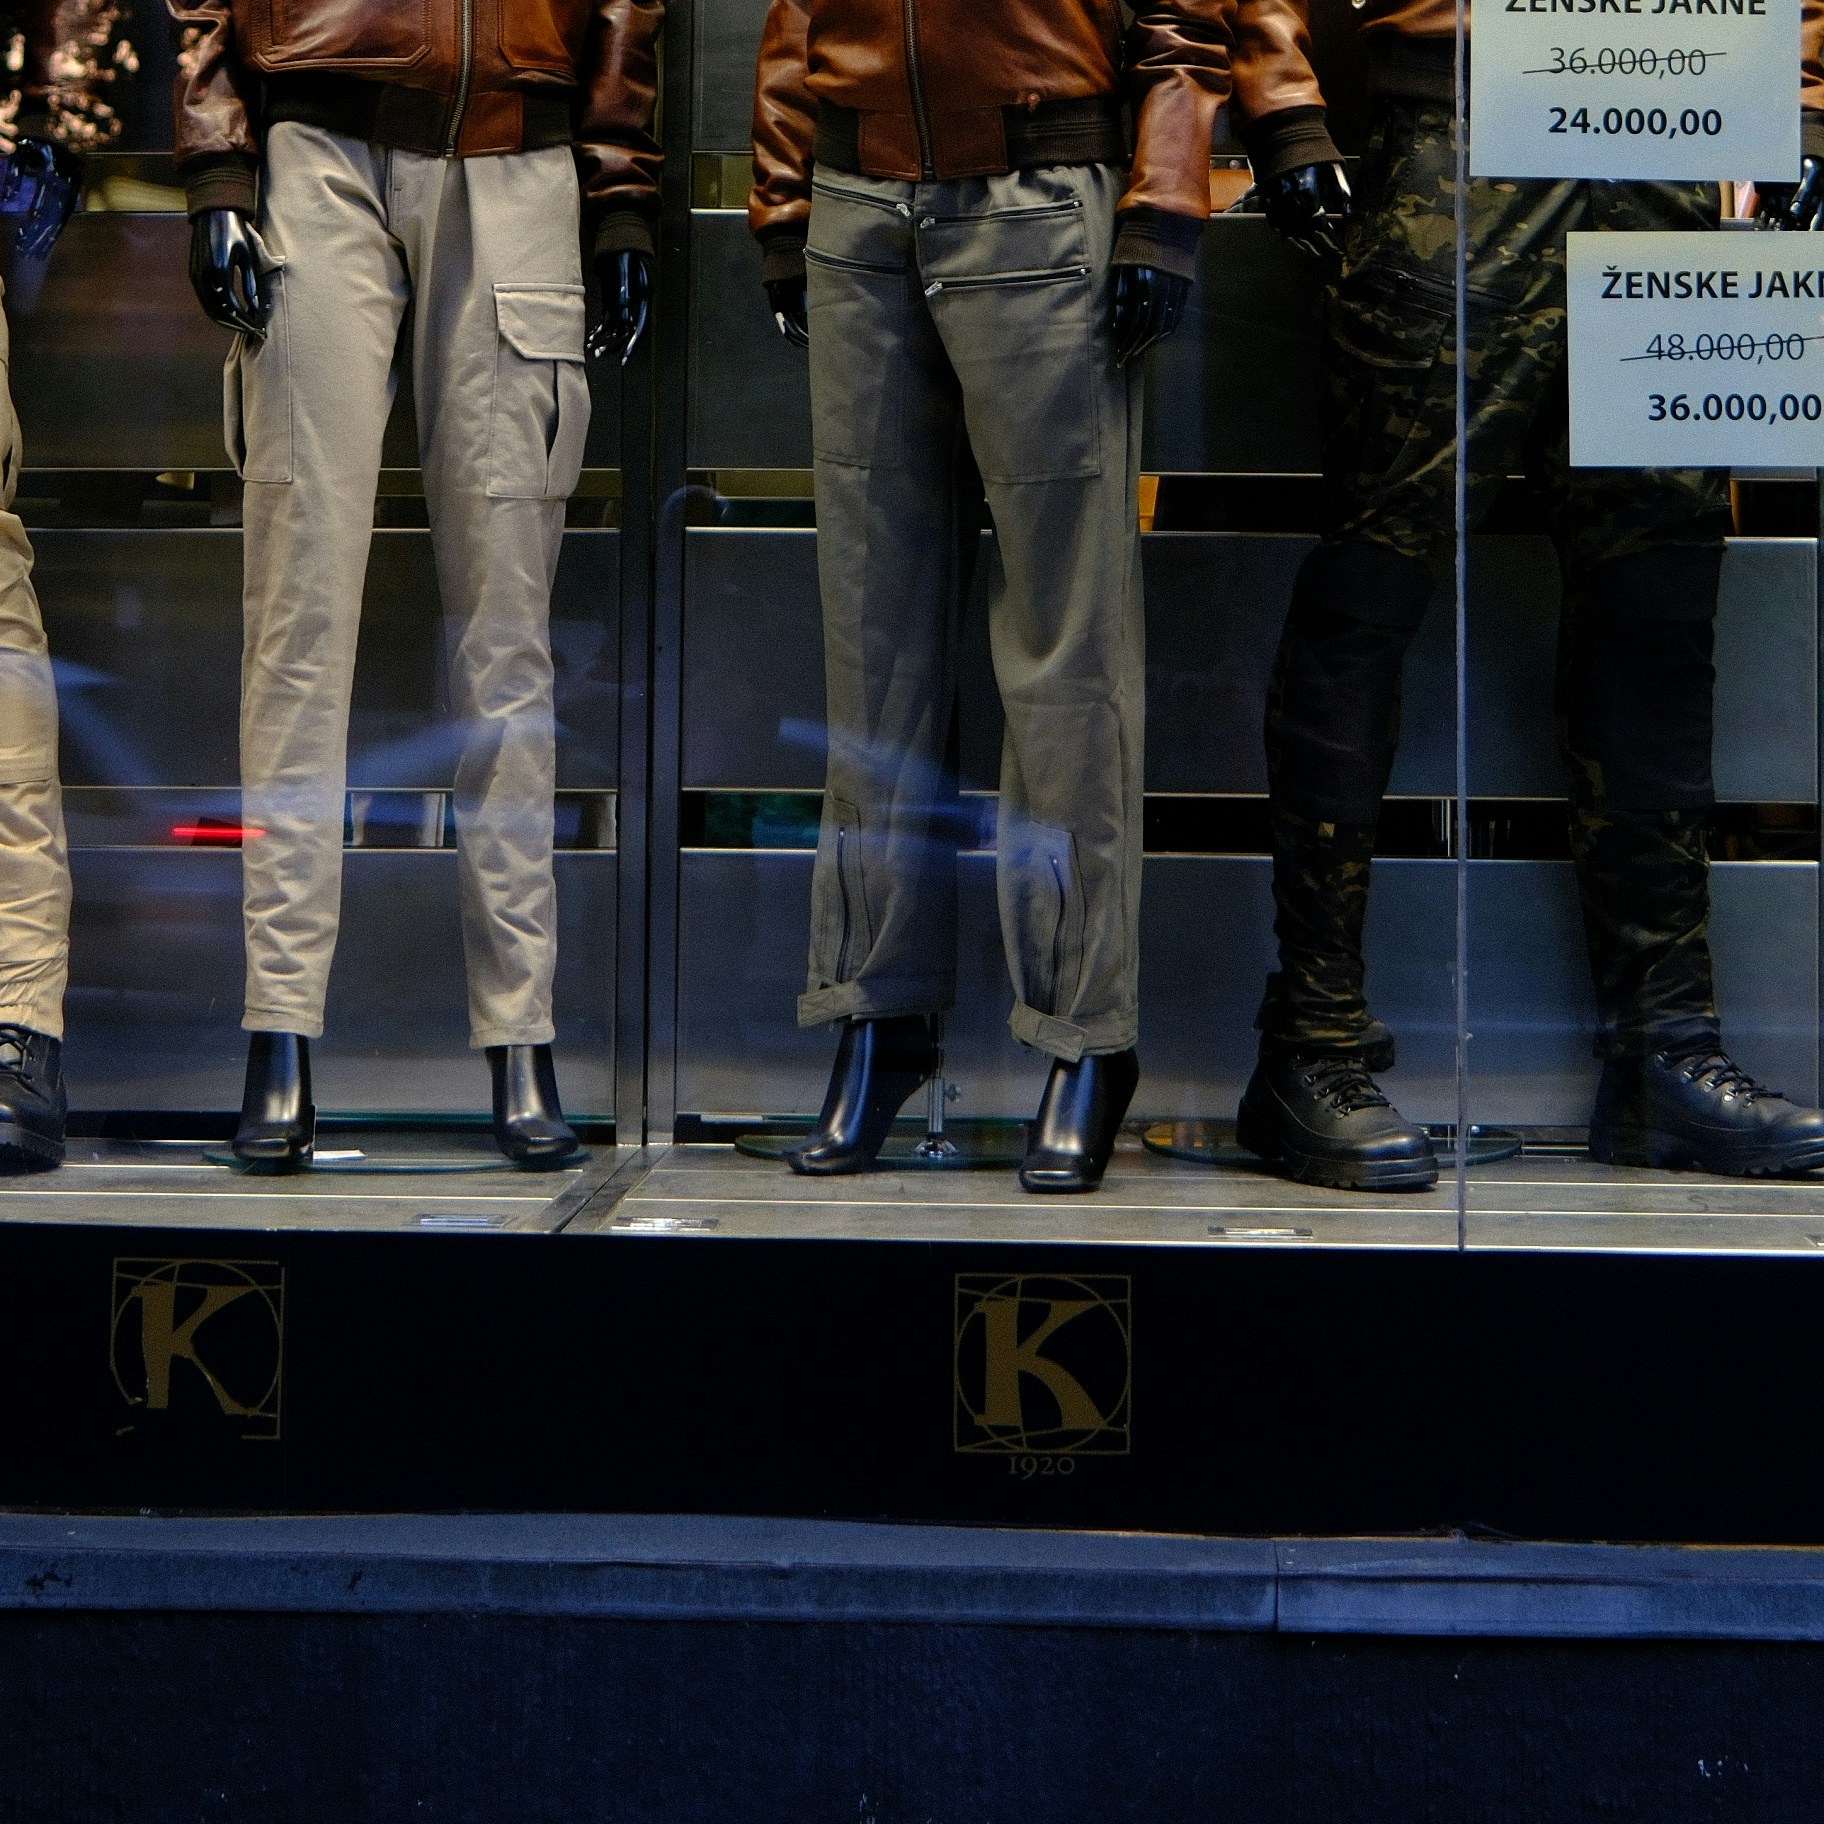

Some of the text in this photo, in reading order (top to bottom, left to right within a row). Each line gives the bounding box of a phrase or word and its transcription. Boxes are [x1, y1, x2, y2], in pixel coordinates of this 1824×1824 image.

[1549, 47, 1706, 80] 36.000,00
[1548, 106, 1723, 140] 24.000,00
[1601, 265, 1739, 299] ŽENSKE
[1646, 333, 1805, 365] 48.000,00
[1648, 393, 1823, 426] 36.000,00
[131, 1283, 261, 1414] K
[974, 1297, 1109, 1428] K
[1008, 1456, 1076, 1480] 1920
